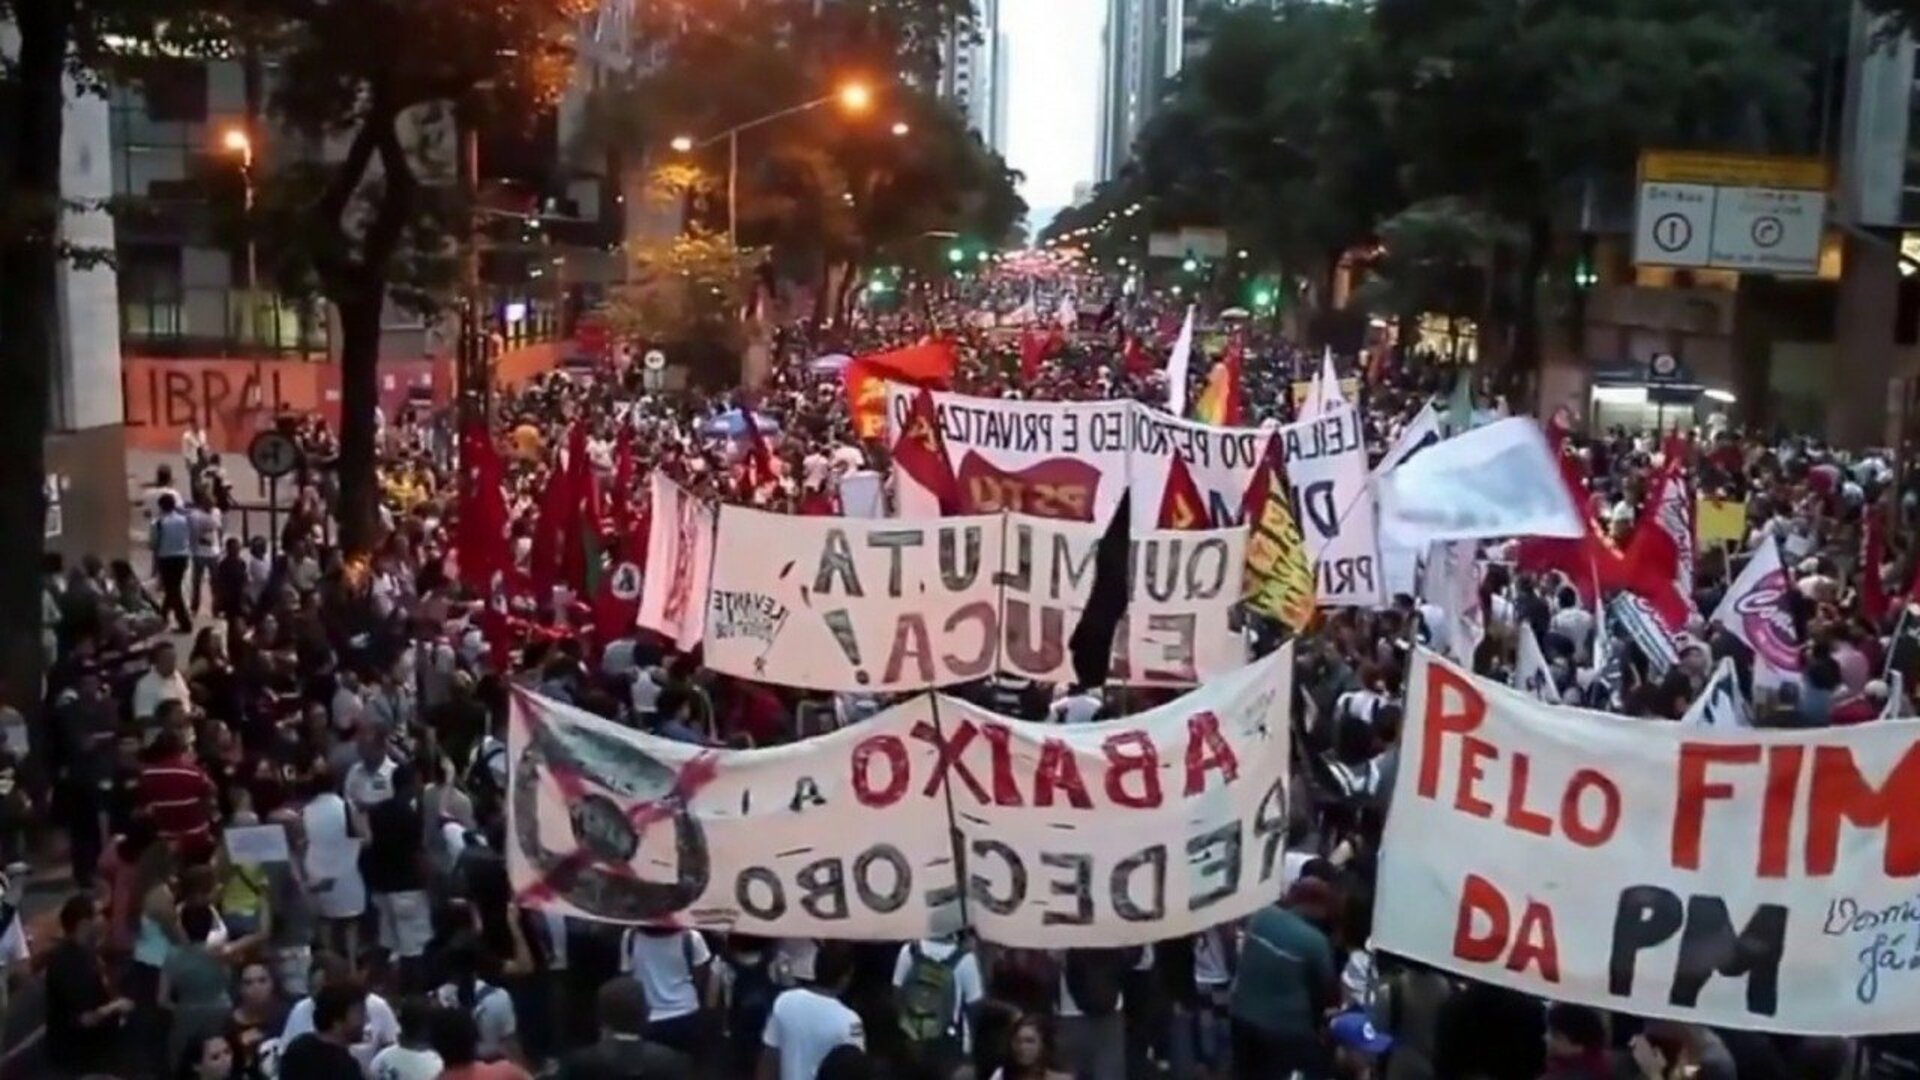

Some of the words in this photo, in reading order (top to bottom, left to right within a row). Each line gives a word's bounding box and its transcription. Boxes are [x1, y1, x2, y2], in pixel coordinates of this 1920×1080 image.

[1417, 662, 1621, 847] PELO
[1671, 740, 1920, 879] FIM
[1453, 873, 1560, 984] DA
[1609, 884, 1788, 1017] PM
